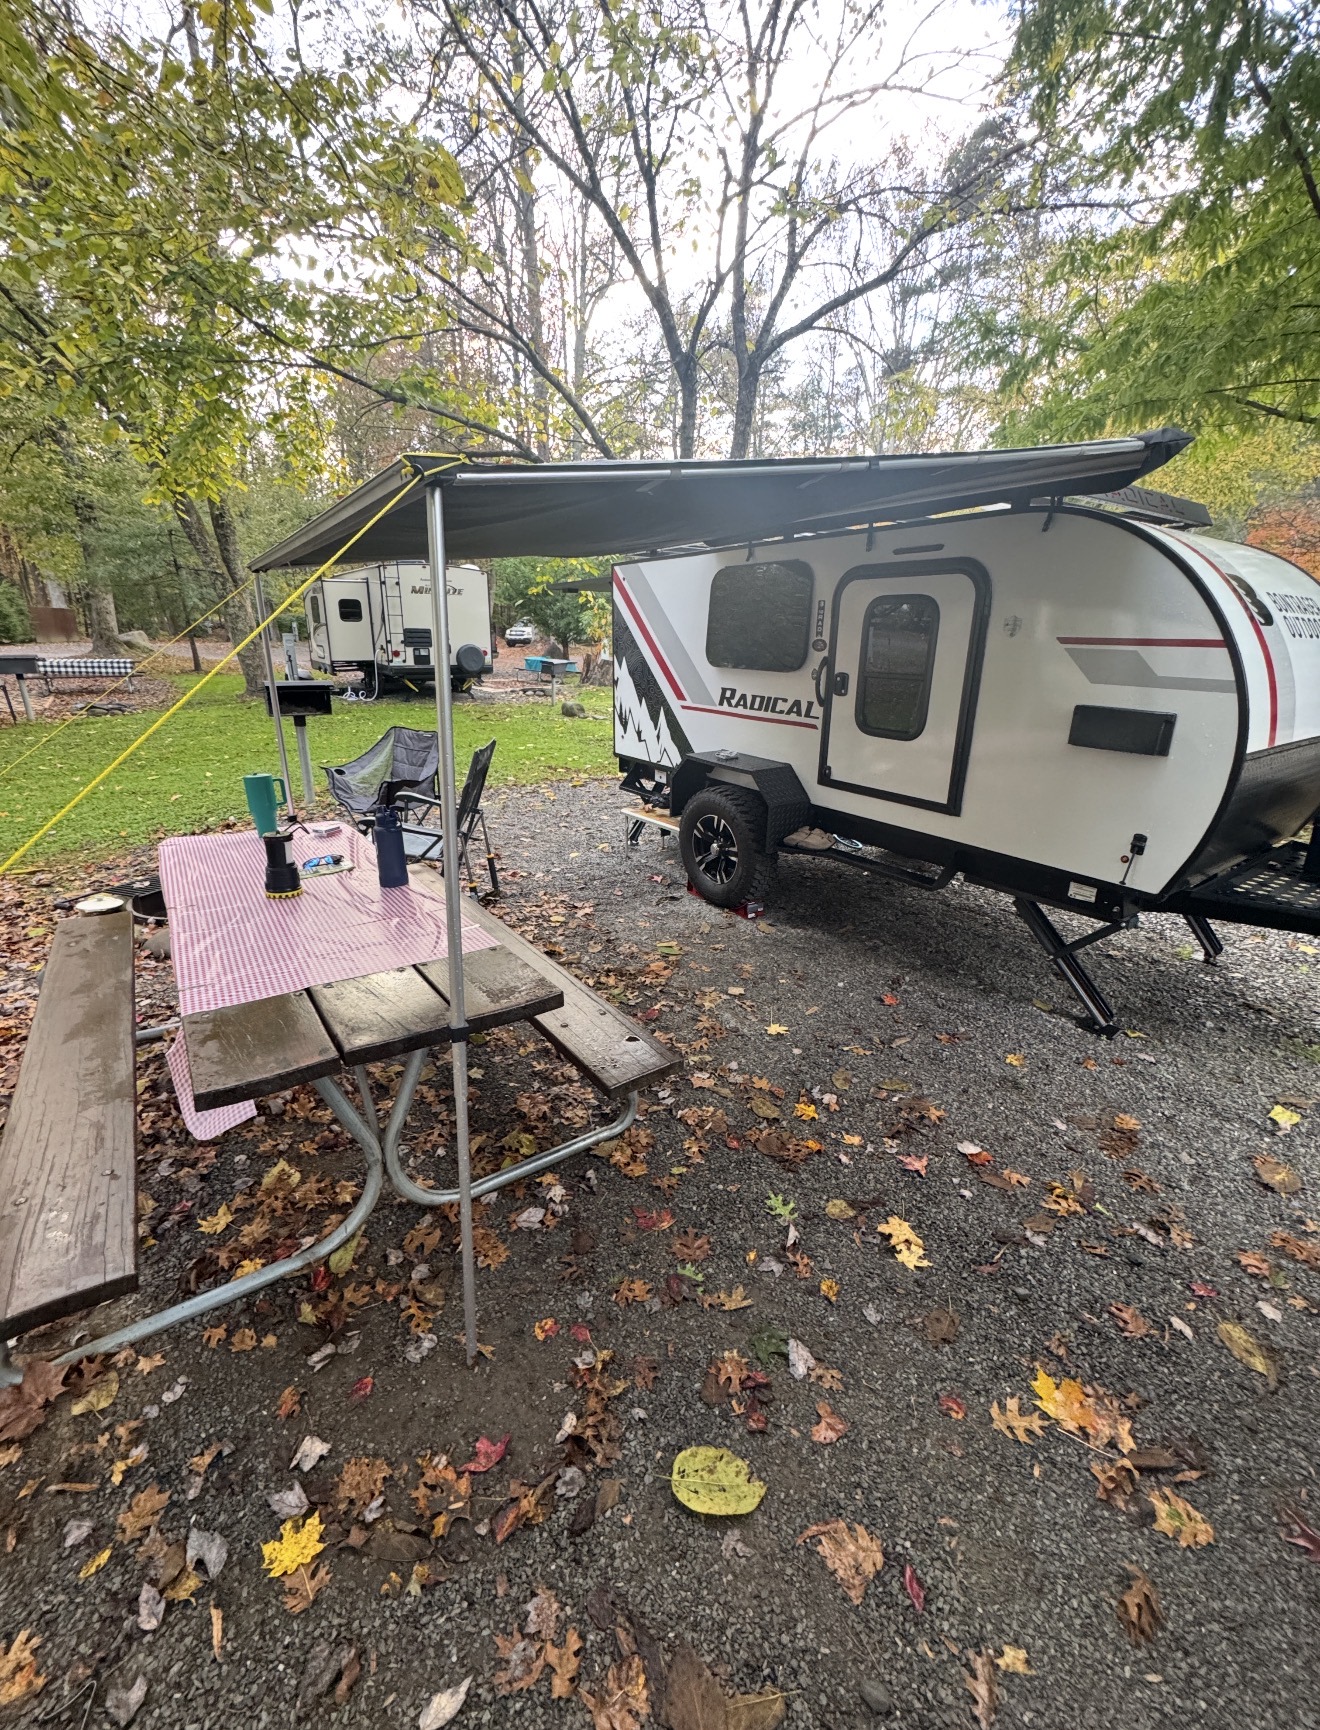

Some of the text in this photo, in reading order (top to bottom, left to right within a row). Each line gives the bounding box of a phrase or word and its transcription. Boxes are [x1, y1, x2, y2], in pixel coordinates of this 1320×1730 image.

[1104, 486, 1185, 515] ADICAL
[1282, 615, 1320, 639] OUTDOO
[719, 688, 819, 719] RADICAL
